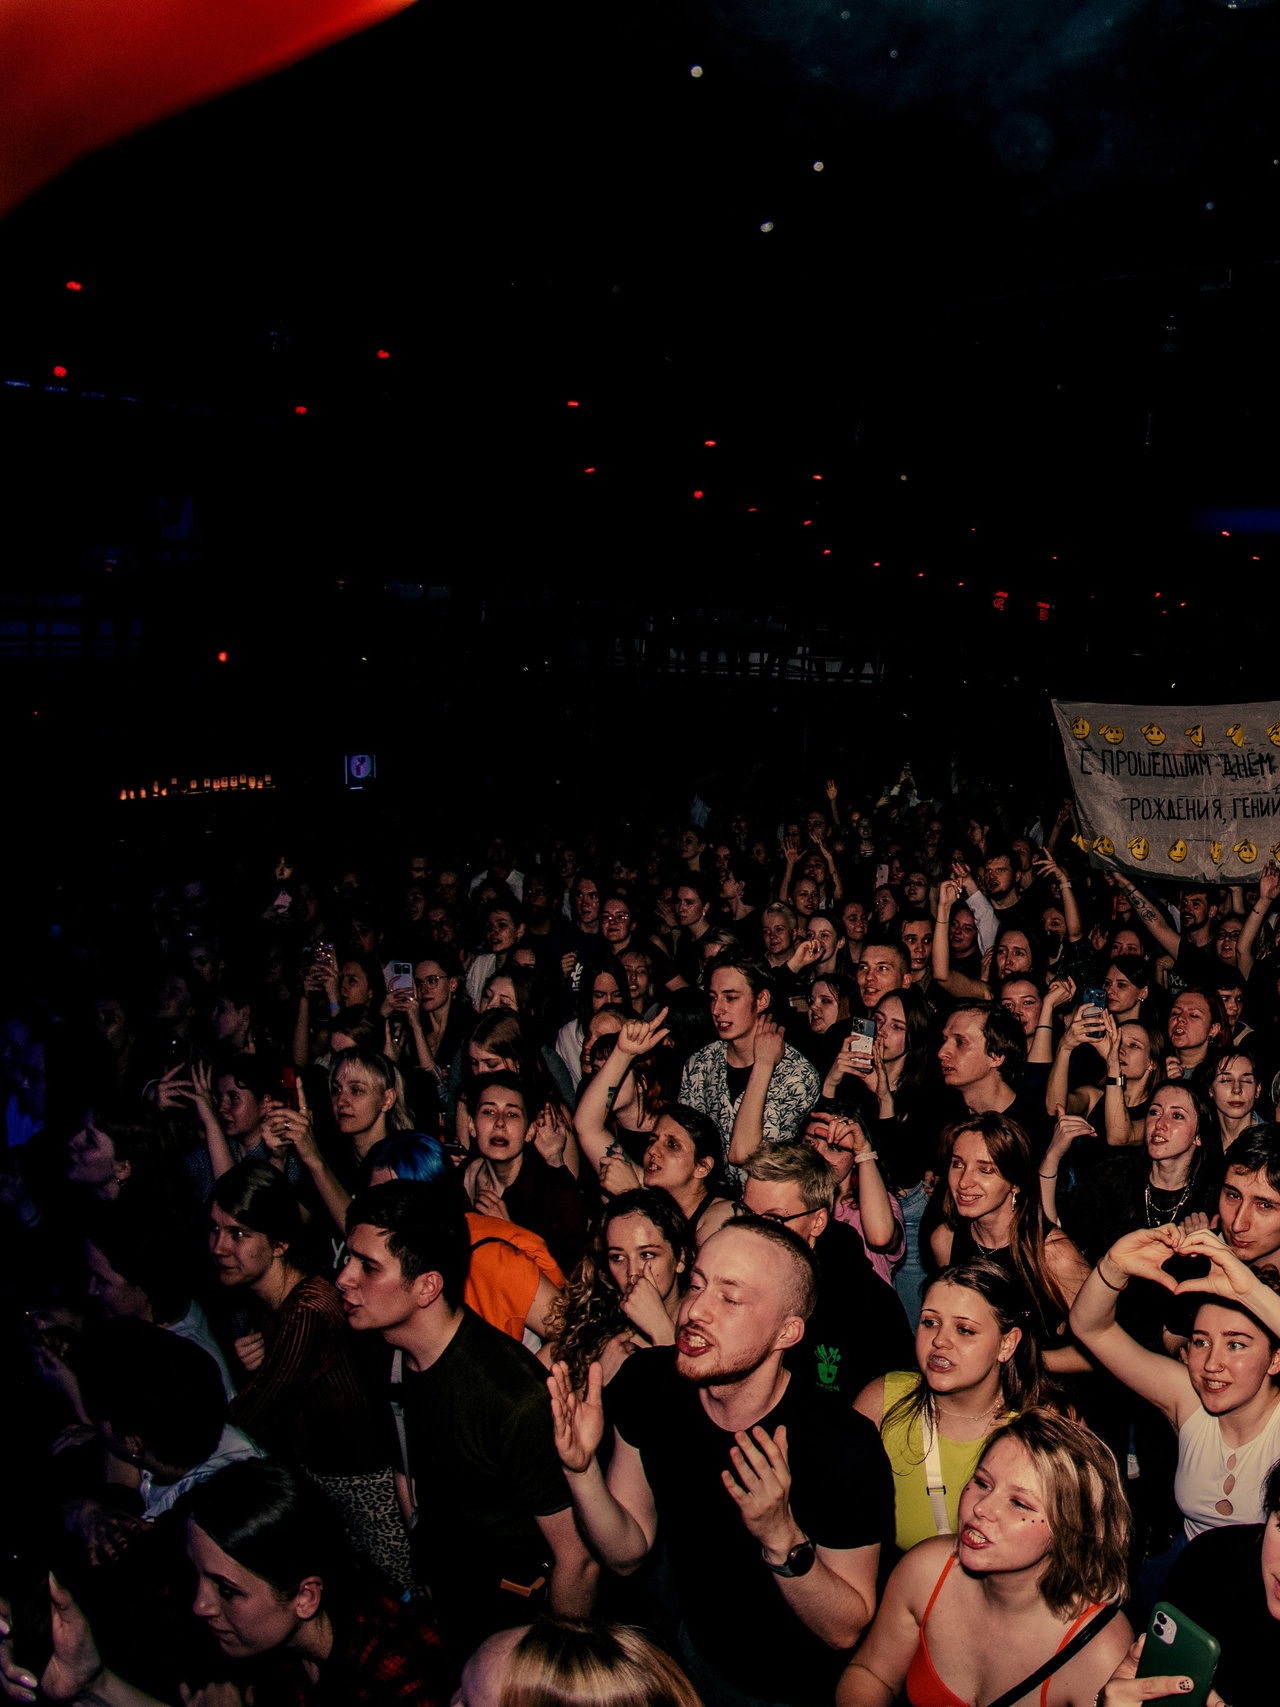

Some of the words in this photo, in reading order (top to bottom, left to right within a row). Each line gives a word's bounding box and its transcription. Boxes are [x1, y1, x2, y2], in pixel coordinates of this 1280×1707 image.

[1080, 747, 1092, 775] С
[1101, 749, 1212, 779] ПРОШЕДШИМ
[1221, 748, 1273, 779] ДНЁМ
[1130, 798, 1228, 825] РОЖДЕНИЯ,
